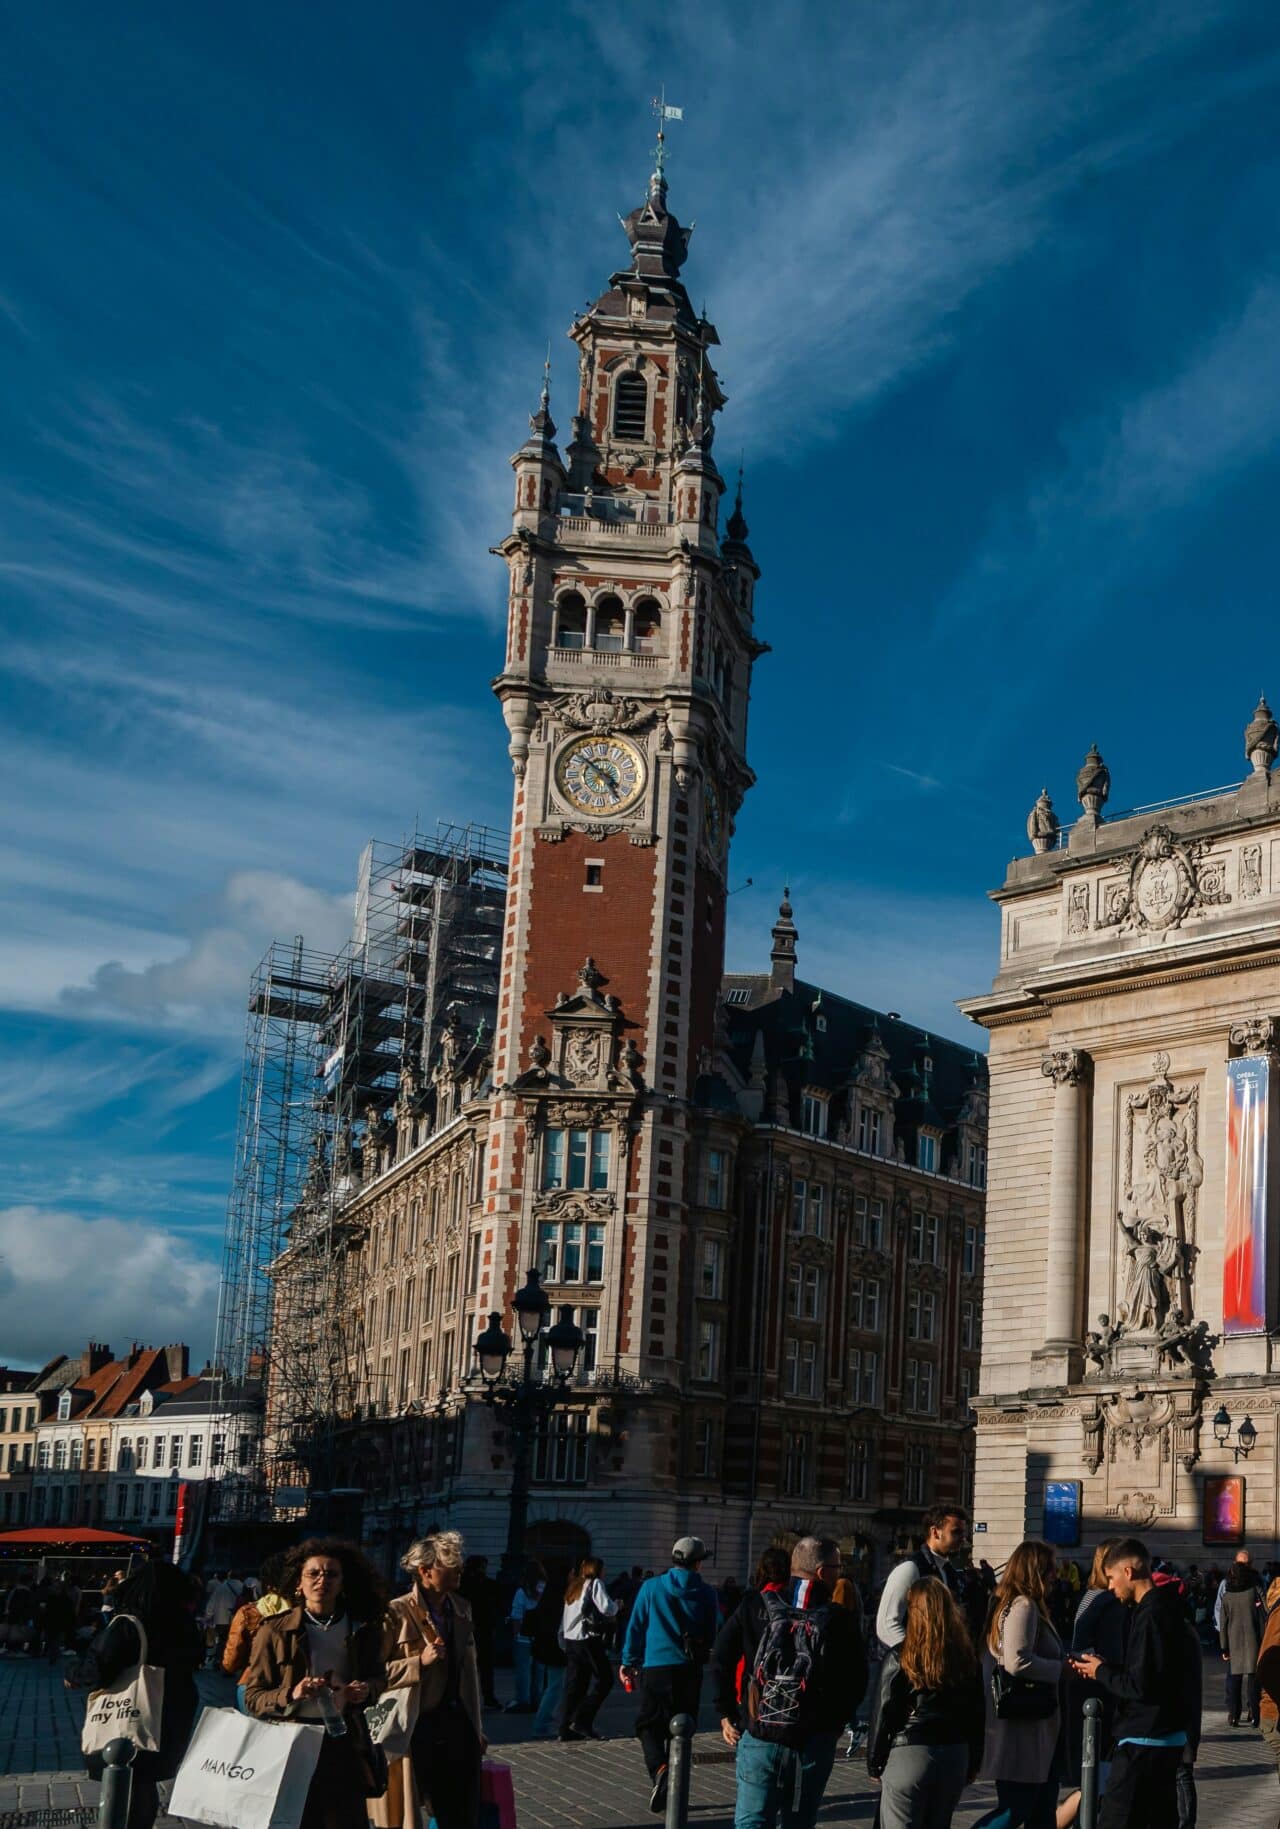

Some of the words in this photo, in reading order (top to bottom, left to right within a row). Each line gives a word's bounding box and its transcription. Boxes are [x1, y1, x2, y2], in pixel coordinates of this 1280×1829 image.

[101, 1697, 132, 1710] love
[91, 1712, 113, 1725] my
[116, 1706, 141, 1720] life
[200, 1758, 255, 1781] MANGO
